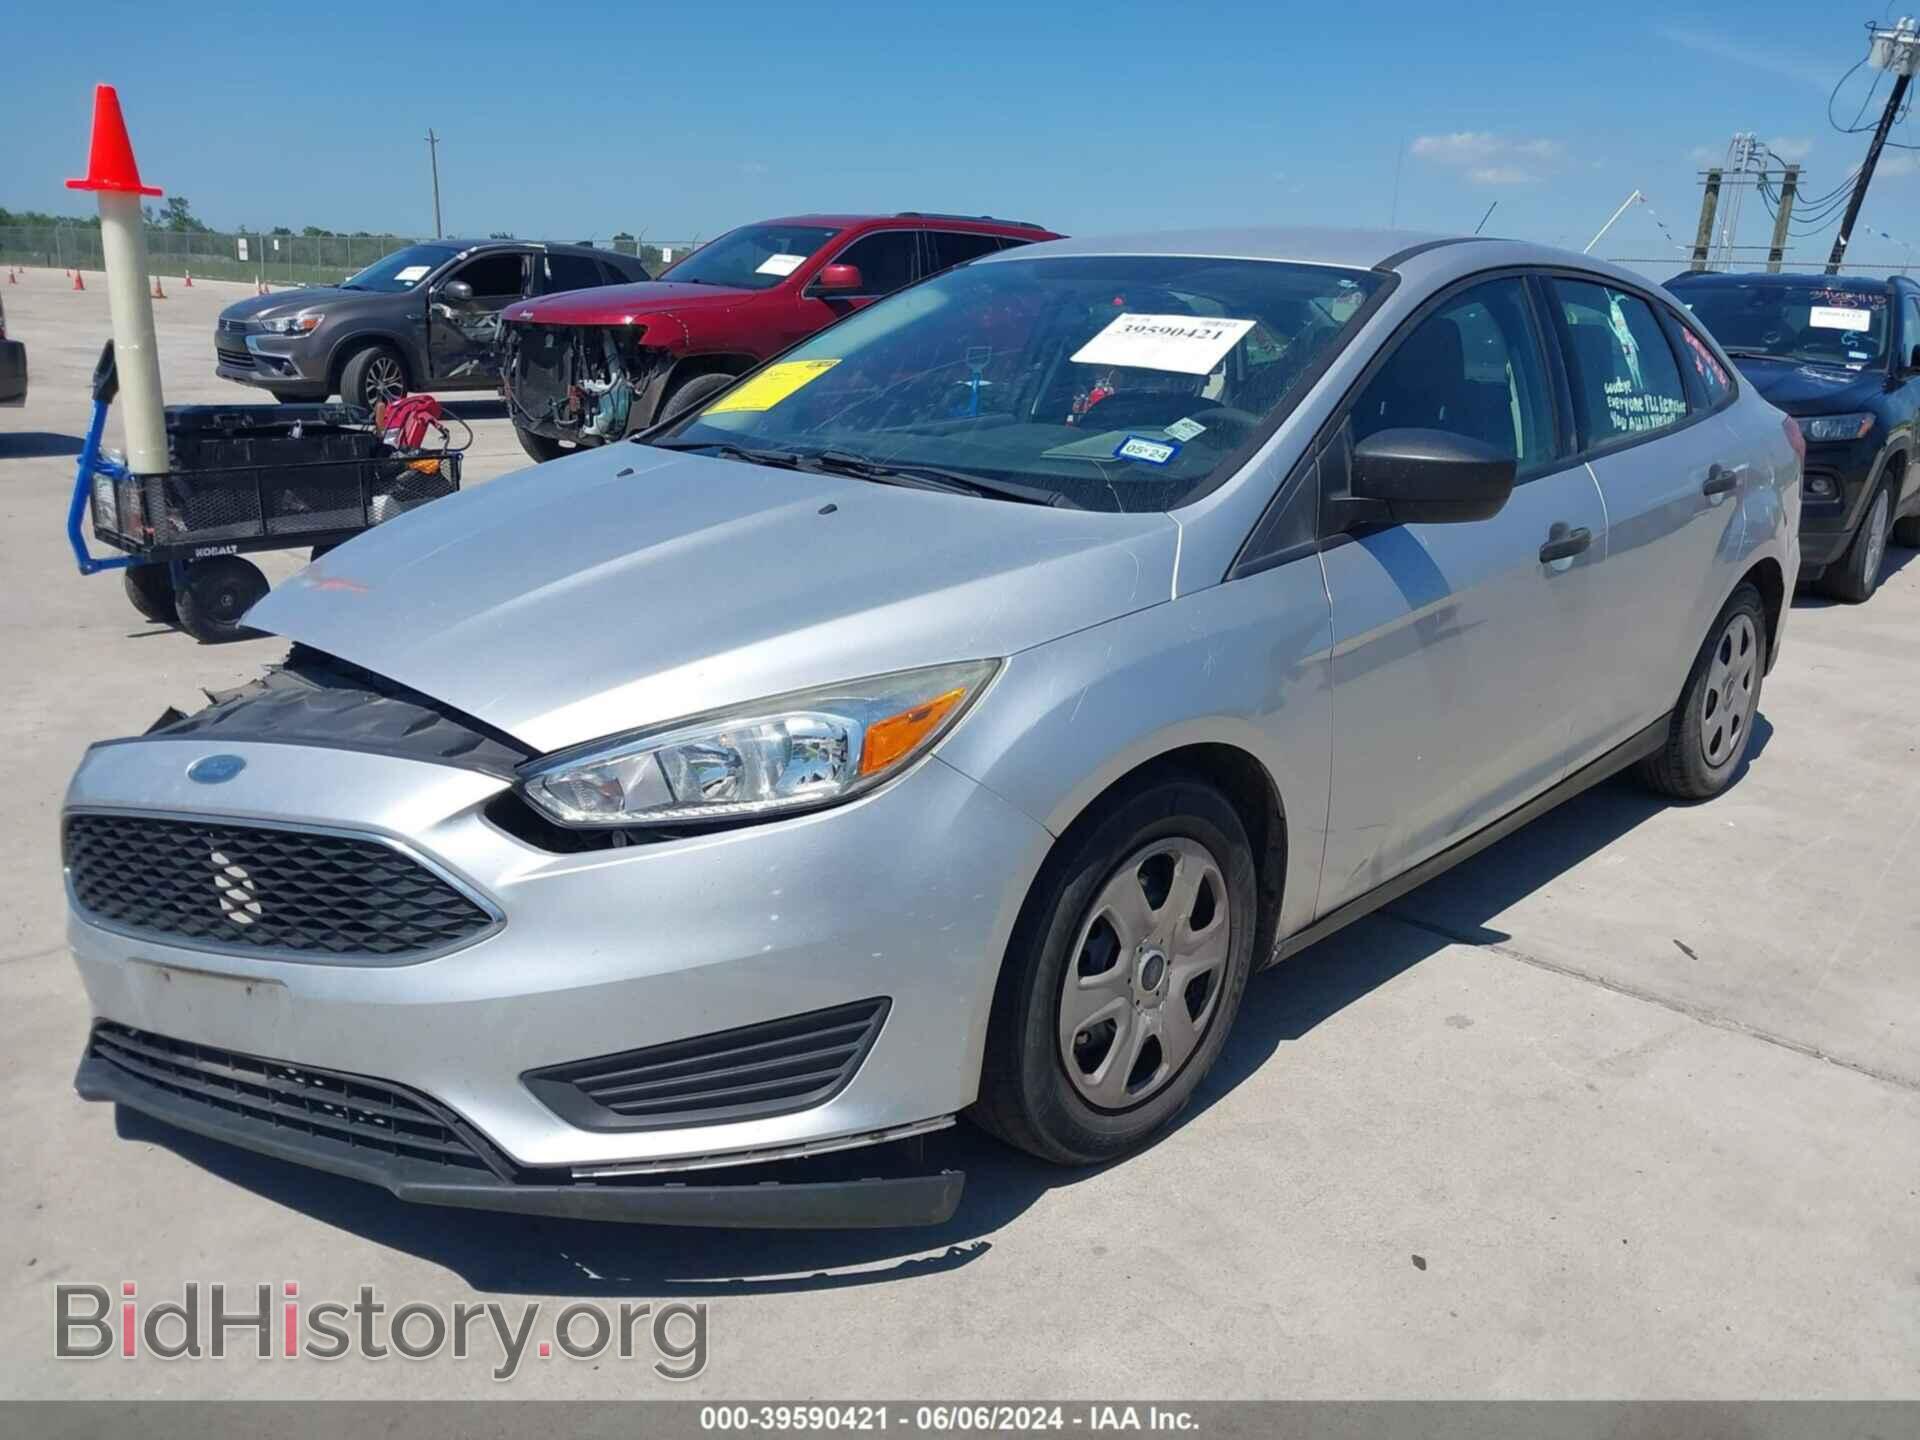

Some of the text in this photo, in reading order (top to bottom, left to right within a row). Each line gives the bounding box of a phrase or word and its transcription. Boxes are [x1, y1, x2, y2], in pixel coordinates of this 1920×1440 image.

[1124, 324, 1224, 340] 39590421
[1126, 444, 1168, 459] 05 24
[195, 545, 238, 557] KOBALT
